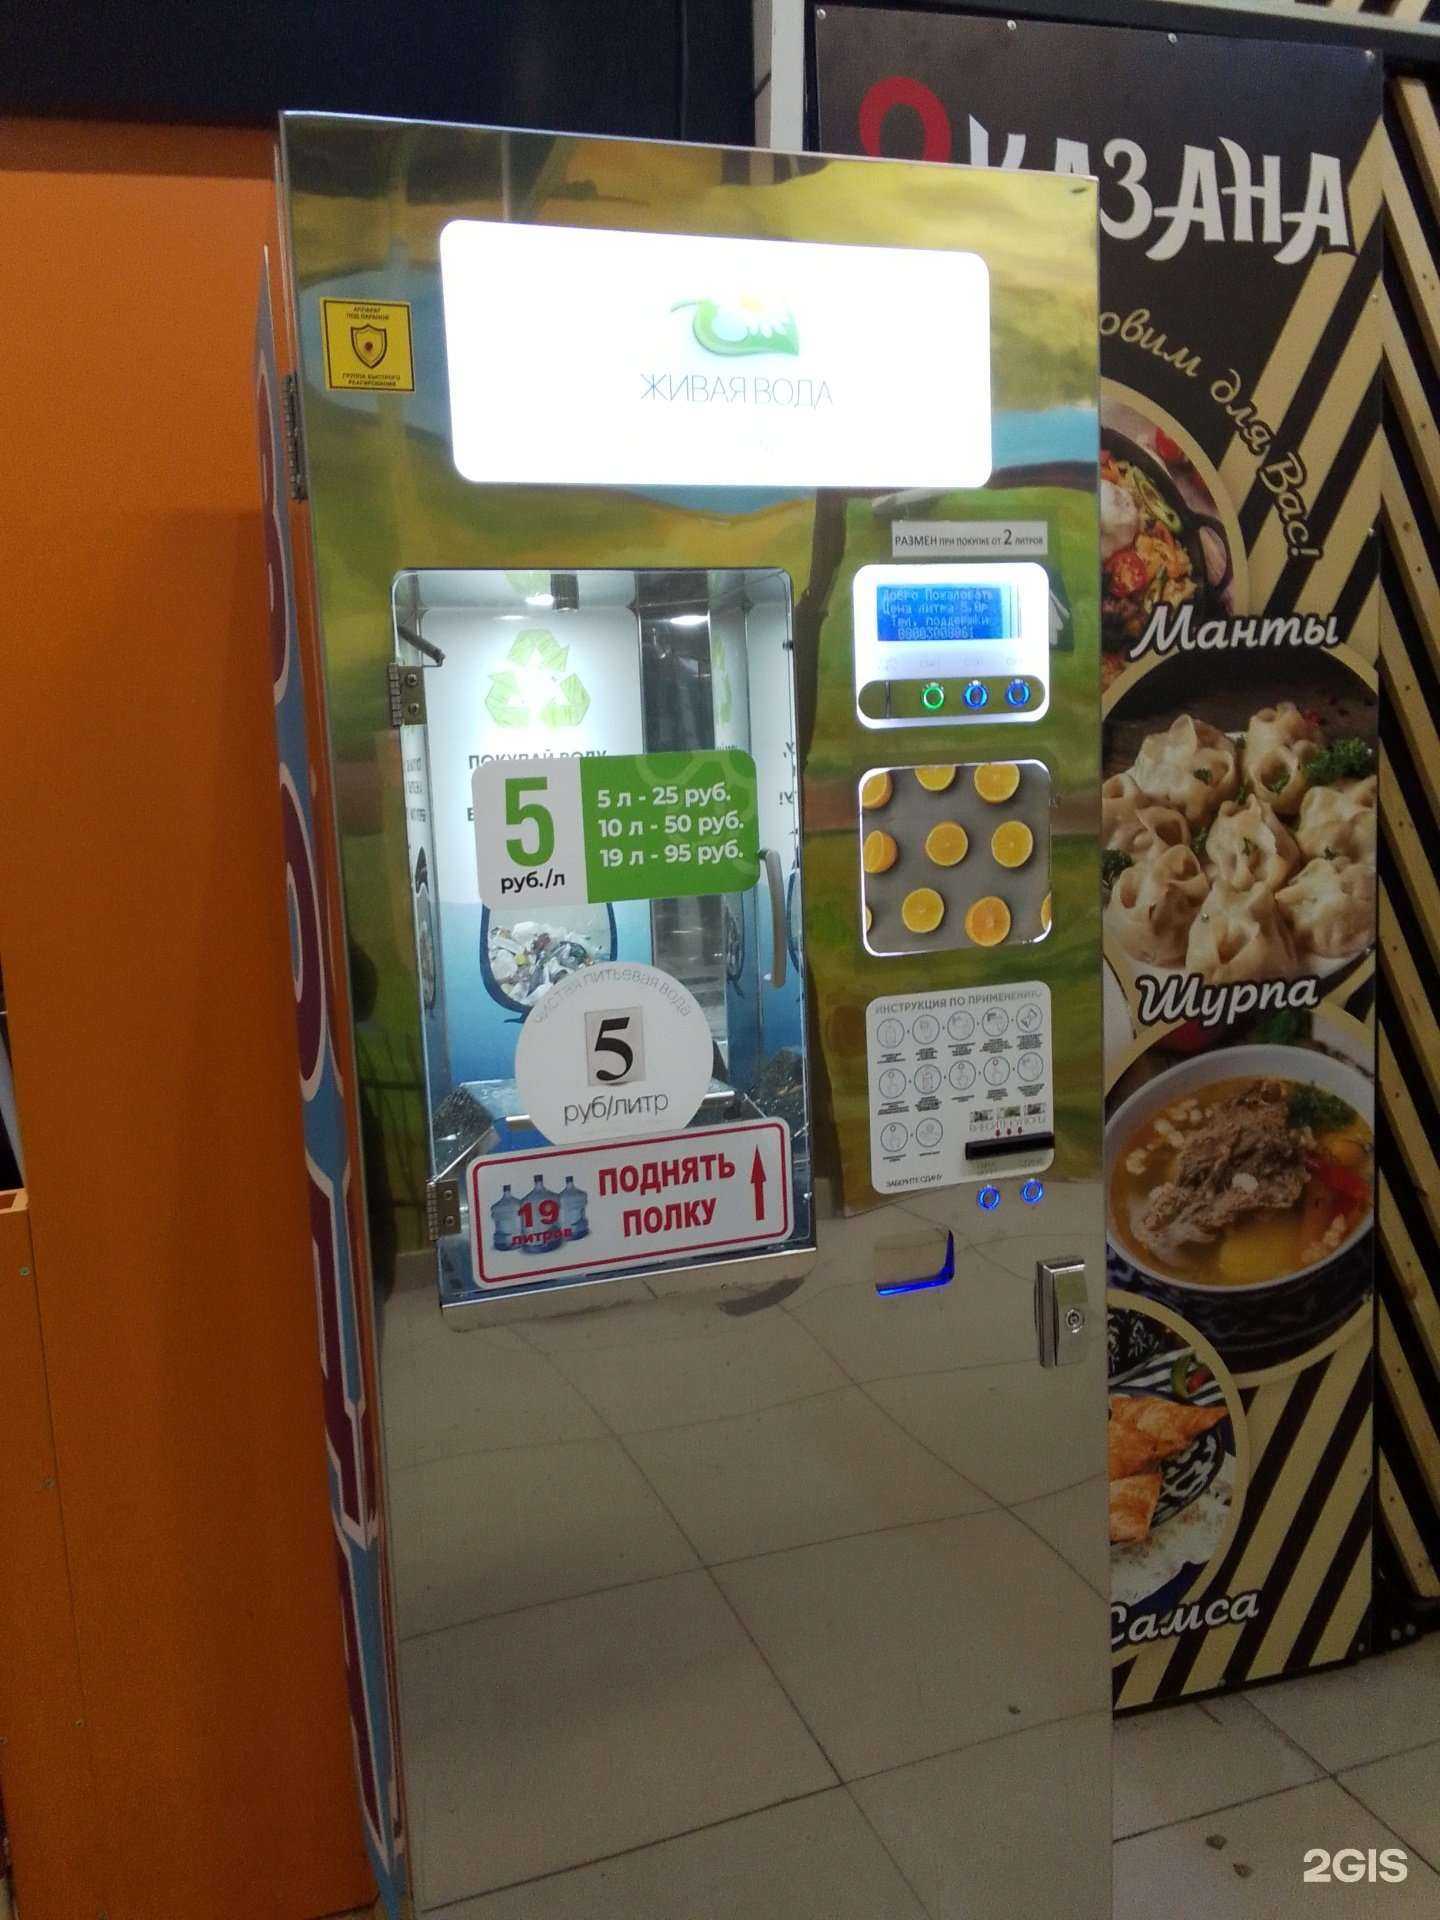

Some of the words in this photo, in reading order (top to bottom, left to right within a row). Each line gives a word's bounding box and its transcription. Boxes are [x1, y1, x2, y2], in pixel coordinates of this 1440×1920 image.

[640, 373, 746, 403] ЖИВАЯ
[754, 376, 833, 410] ВОДА
[1210, 367, 1271, 455] для
[1259, 451, 1322, 557] Вас!
[895, 535, 937, 546] РАЗМЕН
[1003, 528, 1012, 545] 2
[1130, 604, 1339, 659] Манты
[597, 789, 611, 808] 5
[617, 792, 631, 808] л
[652, 786, 679, 806] 25
[685, 782, 731, 808] руб.
[505, 776, 555, 868] 5
[598, 818, 623, 838] 10
[628, 820, 644, 836] л
[664, 814, 692, 834] 50
[698, 810, 744, 837] руб.
[599, 848, 623, 868] 19
[629, 850, 644, 866] л
[664, 843, 692, 863] 95
[697, 839, 744, 865] руб.
[500, 869, 565, 894] руб./л
[875, 998, 947, 1015] ИНСТРУКЦИЯ
[950, 996, 966, 1007] ПО
[1140, 976, 1318, 1027] Шурпа
[594, 1016, 634, 1081] 5
[563, 1093, 669, 1126] руб/литр
[598, 1152, 736, 1196] ПОДНЯТЬ
[517, 1199, 561, 1228] 19
[623, 1198, 717, 1238] ПОЛКУ
[1111, 1591, 1260, 1645] Самса
